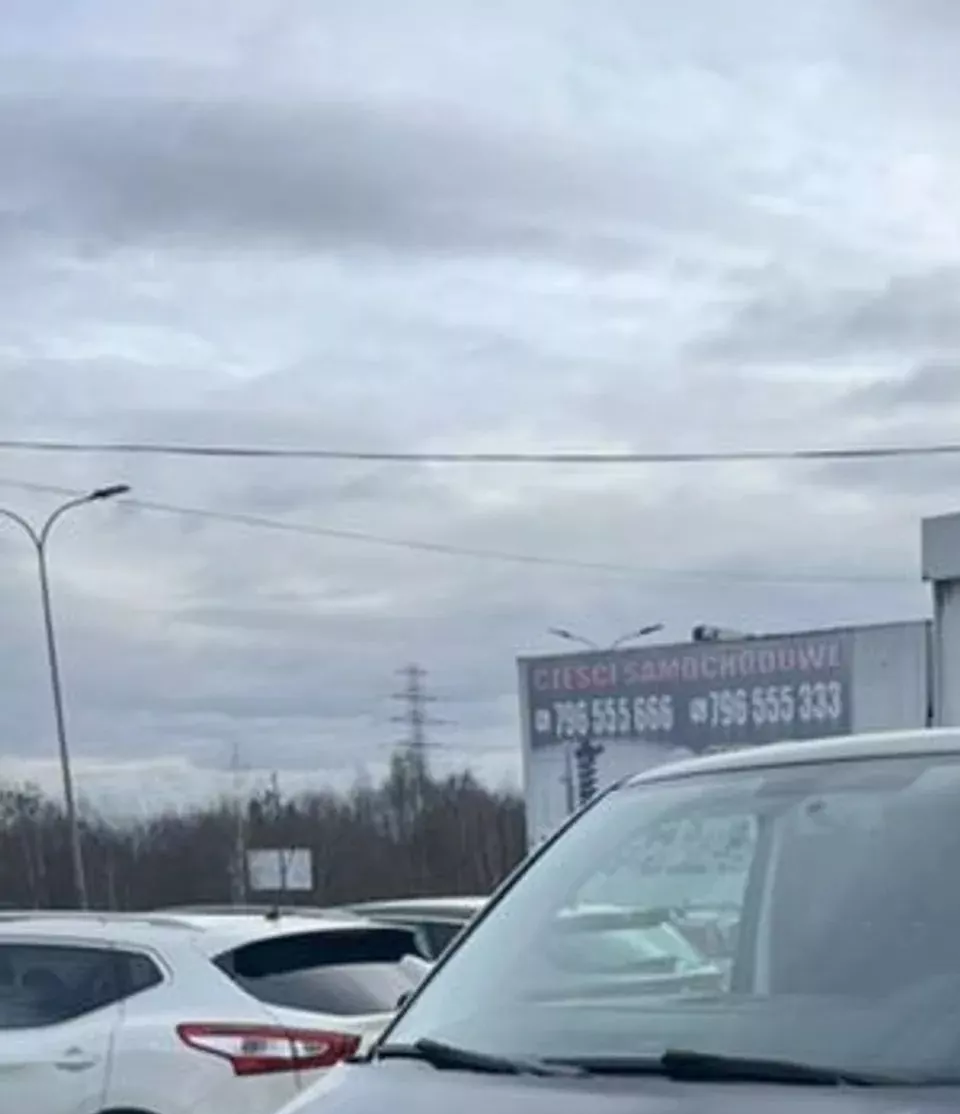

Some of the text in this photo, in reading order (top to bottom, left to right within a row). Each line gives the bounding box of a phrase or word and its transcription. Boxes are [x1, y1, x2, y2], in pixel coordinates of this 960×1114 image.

[592, 697, 631, 734] 555
[752, 684, 794, 725] 555
[799, 680, 842, 720] 333
